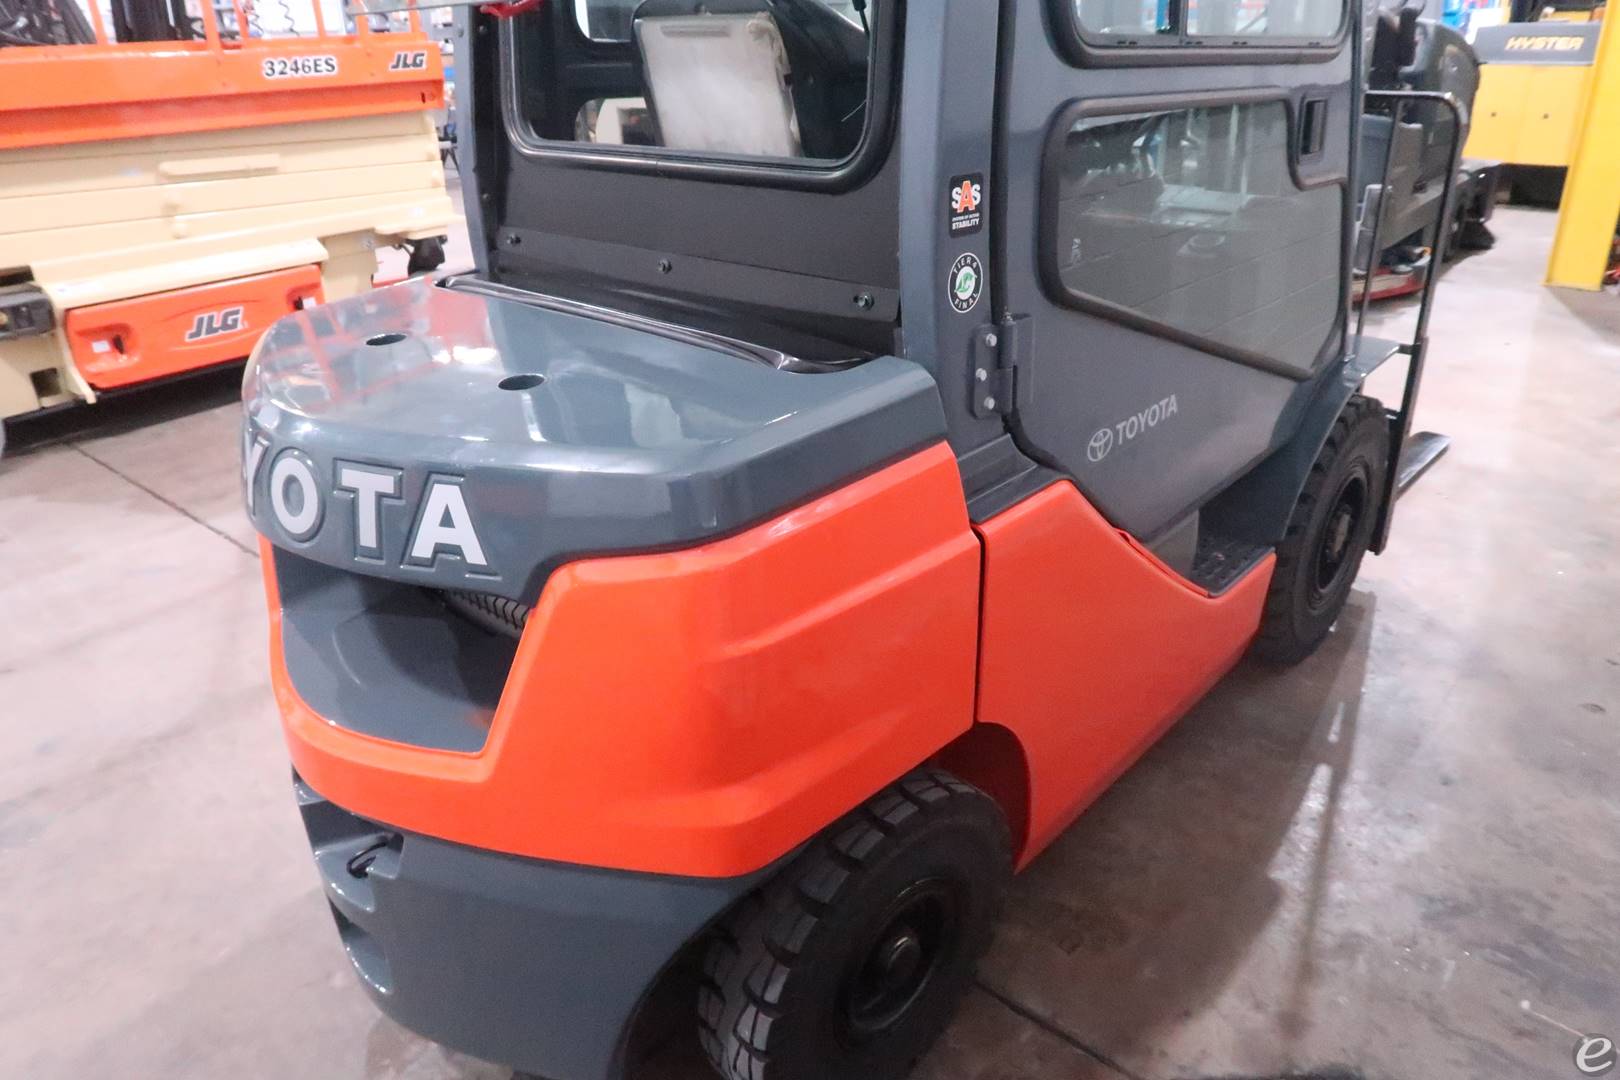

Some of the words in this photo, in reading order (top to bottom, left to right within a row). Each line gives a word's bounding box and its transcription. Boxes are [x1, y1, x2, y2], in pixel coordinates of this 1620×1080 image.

[1504, 36, 1584, 51] HYSTER
[265, 57, 337, 77] 3246ES
[390, 53, 425, 69] JLG
[951, 180, 981, 213] SAS
[952, 218, 979, 230] STABILITY
[186, 307, 243, 341] JLG
[1116, 394, 1178, 445] TOYOTA
